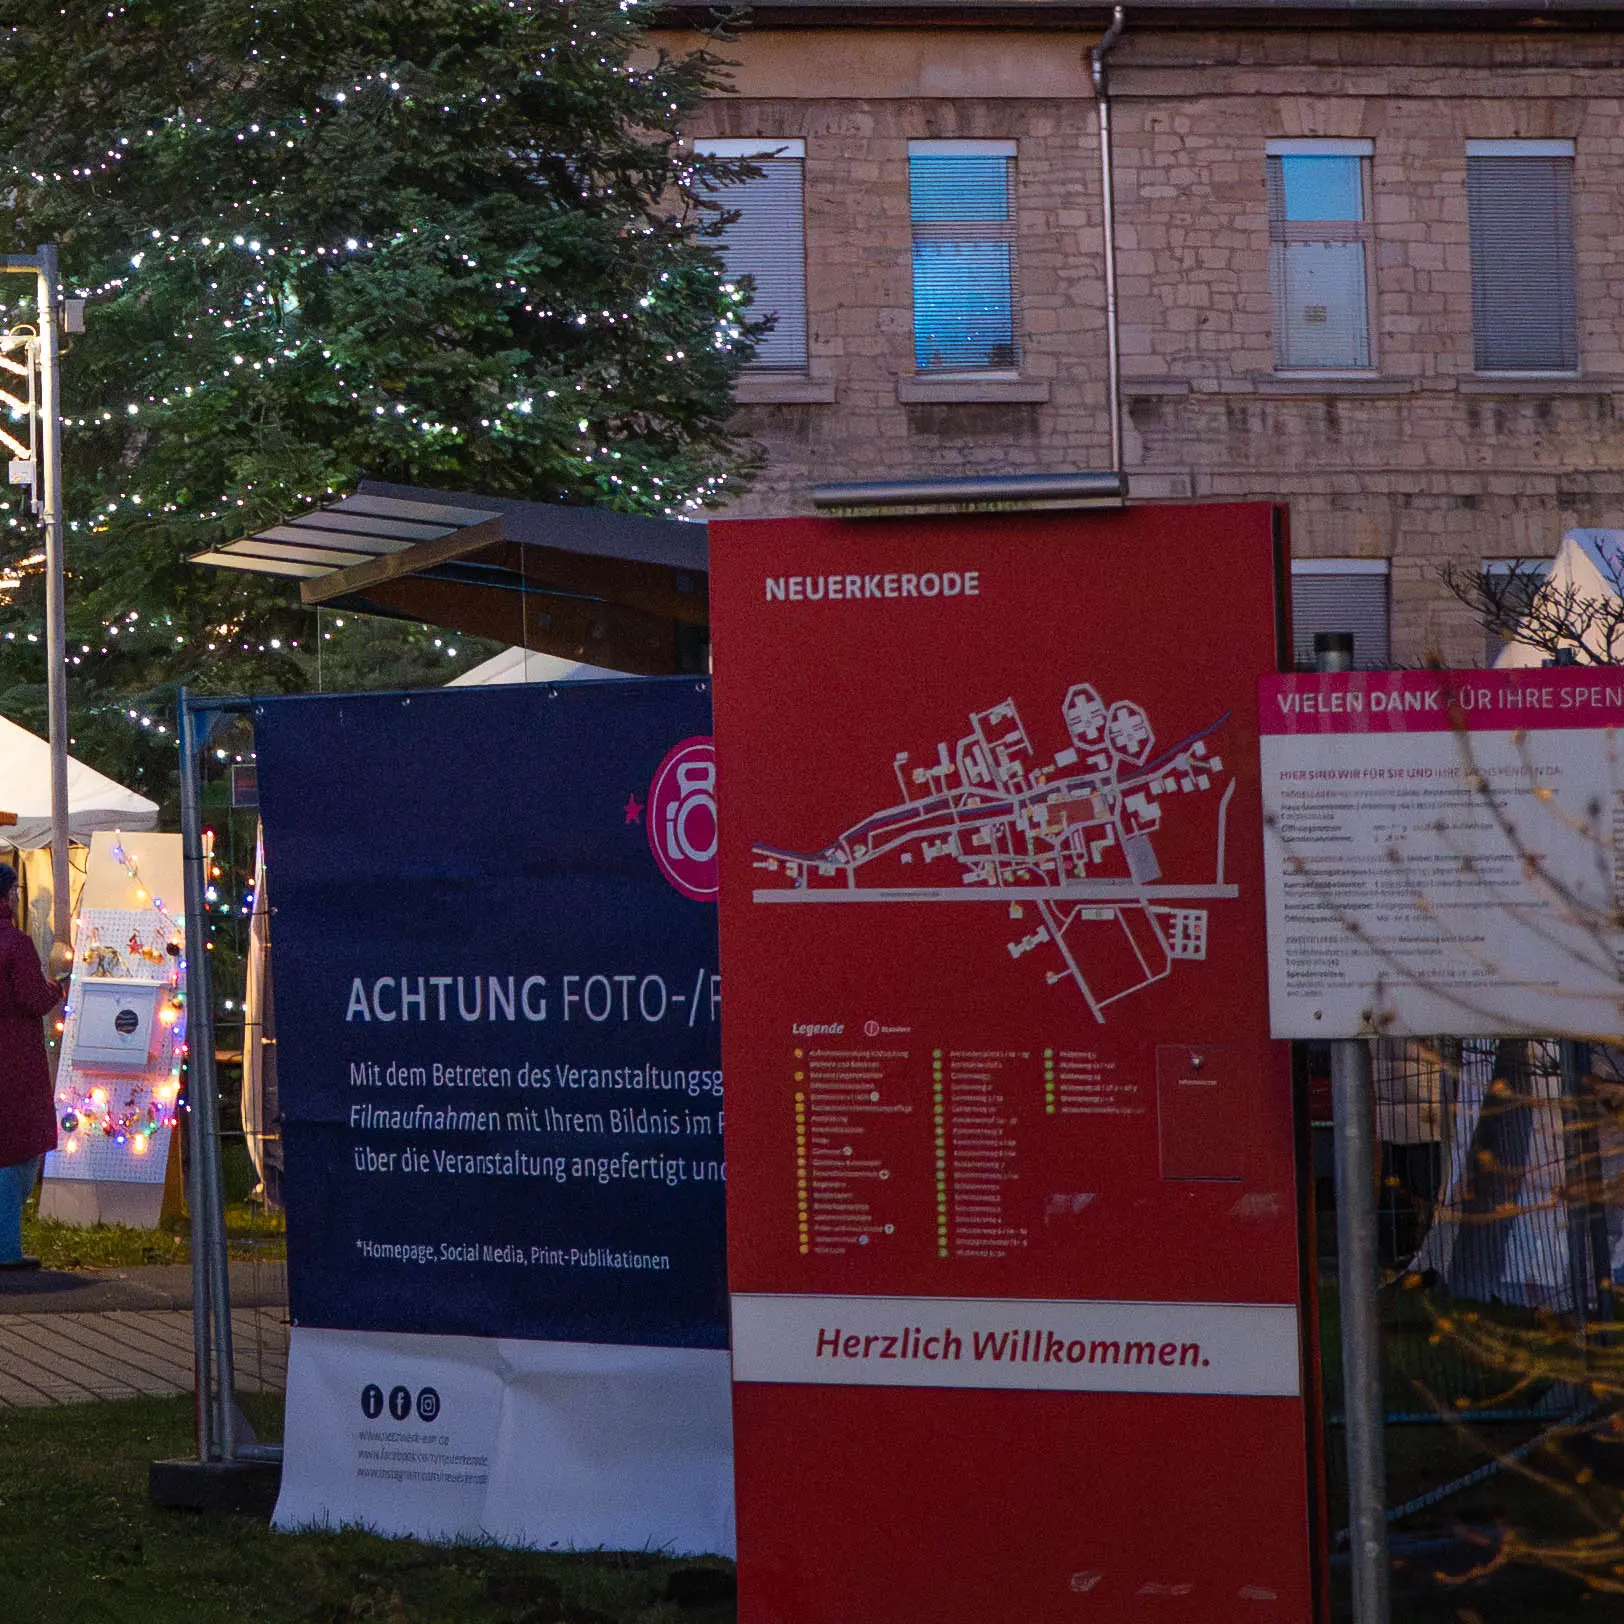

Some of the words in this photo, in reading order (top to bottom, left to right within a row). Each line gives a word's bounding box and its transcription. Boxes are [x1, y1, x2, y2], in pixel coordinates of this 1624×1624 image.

[765, 571, 980, 601] NEUERKERODE
[1277, 691, 1363, 714] VIELEN
[1370, 689, 1440, 712] DANK
[1498, 686, 1554, 711] IHRE
[1559, 685, 1624, 710] SPEN
[1362, 767, 1385, 780] FÜR
[1387, 768, 1405, 779] SIE
[1407, 767, 1433, 779] UND
[344, 975, 548, 1024] ACHTUNG
[792, 1022, 845, 1037] Legende
[349, 1061, 382, 1088] Mit
[386, 1061, 427, 1088] dem
[432, 1062, 512, 1088] Betreten
[517, 1062, 551, 1089] des
[349, 1103, 501, 1132] Filmaufnahmen
[506, 1107, 541, 1133] mit
[545, 1106, 603, 1134] Ihrem
[609, 1108, 680, 1135] Bildnis
[685, 1111, 713, 1136] im
[354, 1146, 397, 1173] über
[401, 1146, 430, 1174] die
[433, 1149, 567, 1183] Veranstaltung
[571, 1153, 686, 1186] angefertigt
[440, 1242, 480, 1262] Social
[482, 1244, 528, 1266] Media,
[530, 1246, 671, 1270] Print-Publikationen
[814, 1326, 962, 1362] Herzlich
[971, 1329, 1211, 1368] Willkommen.
